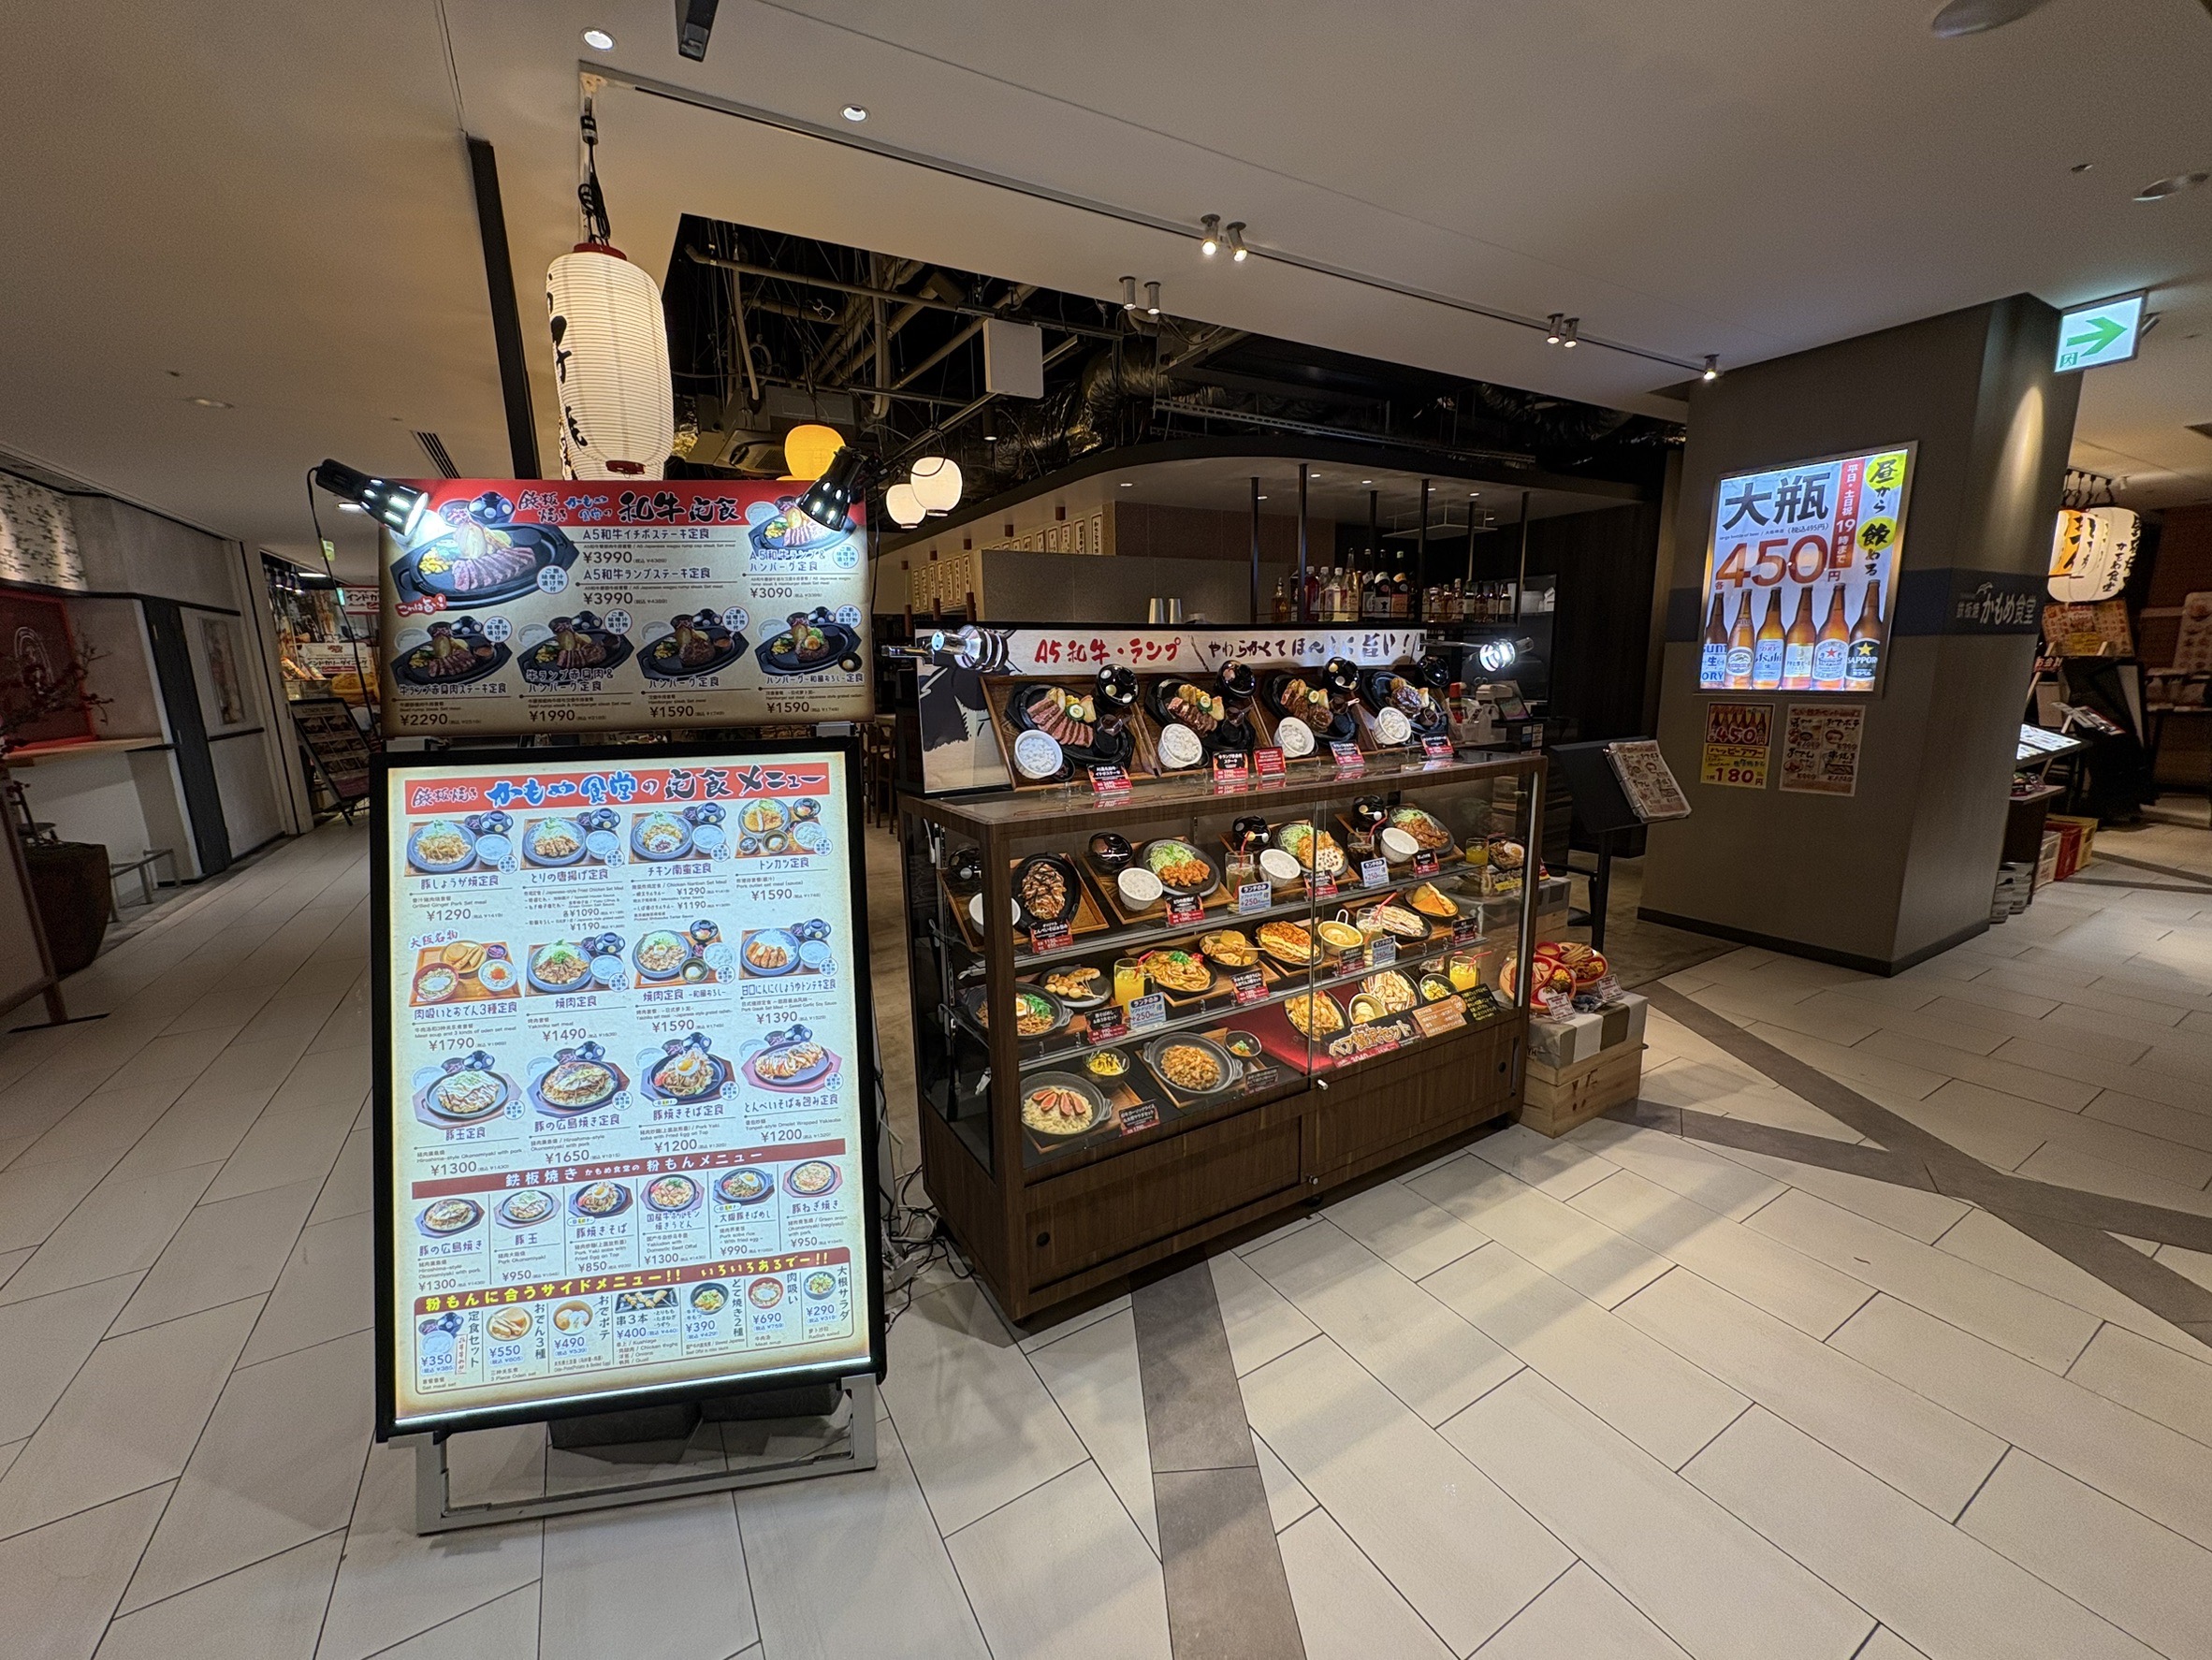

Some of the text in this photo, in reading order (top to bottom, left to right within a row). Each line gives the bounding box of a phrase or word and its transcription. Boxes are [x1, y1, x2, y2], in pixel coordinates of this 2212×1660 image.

[1870, 459, 1899, 514] 昼から
[618, 490, 741, 523] 和牛定食
[1722, 472, 1831, 531] 大瓶
[1836, 462, 1859, 564] 平日・土日祝 19 時まで
[583, 528, 710, 541] A5和牛イチボステーキ定食
[1861, 522, 1889, 576] 飲める
[583, 551, 633, 564] ¥3990
[1715, 534, 1841, 590] 各 450 円
[749, 561, 818, 572] ハンバーグ定食
[583, 591, 633, 605] ¥3990
[750, 587, 793, 599] ¥3090
[1035, 637, 1183, 665] A5和牛・ランプ
[529, 681, 602, 692] ハンバーグ定食
[648, 677, 720, 689] ハンバーグ定食
[649, 706, 694, 718] ¥1590
[766, 702, 809, 714] ¥1590
[400, 713, 448, 726] ¥2290
[530, 709, 575, 722] ¥1990
[1716, 727, 1756, 743] 450
[1715, 767, 1754, 783] 180
[412, 786, 478, 808] 鉄板焼き
[648, 862, 711, 877] チキン南蛮定食
[760, 857, 809, 870] トンカツ定食
[421, 875, 499, 890] 豚しょうが焼定食
[531, 868, 608, 883] とりの唐揚げ定食
[677, 887, 706, 896] ¥1290
[751, 888, 793, 901] ¥1590
[677, 901, 706, 910] ¥1190
[427, 909, 471, 922] ¥1290
[570, 922, 600, 931] ¥1190
[409, 929, 458, 949] 大阪名物
[643, 989, 684, 1001] 焼肉定食
[1133, 996, 1159, 1007] ランチのみ
[555, 996, 597, 1009] 焼肉定食
[415, 1001, 517, 1020] 肉吸いとおでん3種定食
[756, 1011, 797, 1025] ¥1390
[652, 1019, 694, 1032] ¥1590
[543, 1027, 587, 1041] ¥1490
[429, 1037, 474, 1051] ¥1790
[653, 1104, 723, 1121] 豚焼きそば定食
[534, 1114, 619, 1132] 豚の広島焼き定食
[761, 1129, 802, 1143] ¥1200
[654, 1139, 698, 1153] ¥1200
[545, 1149, 589, 1164] ¥1650
[430, 1161, 477, 1176] ¥1300
[505, 1167, 578, 1187] 鉄板焼き
[646, 1151, 763, 1172] 粉もんメニュー
[792, 1200, 838, 1215] 豚ねぎ焼き
[576, 1222, 628, 1239] 豚焼きそば
[655, 1220, 692, 1230] 焼きうどん
[419, 1240, 482, 1257] 豚の広島焼き
[791, 1236, 818, 1247] ¥950
[720, 1245, 748, 1256] ¥990
[644, 1253, 679, 1264] ¥1300
[578, 1261, 607, 1273] ¥850
[426, 1252, 829, 1312] 粉もんに合うサイドメニュー!! いろいろあるでー!!
[502, 1270, 531, 1281] ¥950
[418, 1278, 456, 1291] ¥1300
[787, 1273, 798, 1304] 肉吸い
[837, 1266, 851, 1321] 大根サラダ
[732, 1278, 744, 1337] どて焼き2種
[806, 1304, 835, 1317] ¥290
[599, 1295, 610, 1341] おでポテ
[616, 1313, 648, 1326] 串3本
[752, 1312, 781, 1324] ¥690
[534, 1303, 546, 1361] おでん3種
[617, 1327, 647, 1339] ¥400
[685, 1320, 716, 1332] ¥390
[468, 1311, 480, 1369] 定食セット
[554, 1336, 585, 1349] ¥490
[488, 1345, 520, 1358] ¥550
[421, 1353, 453, 1366] ¥350
